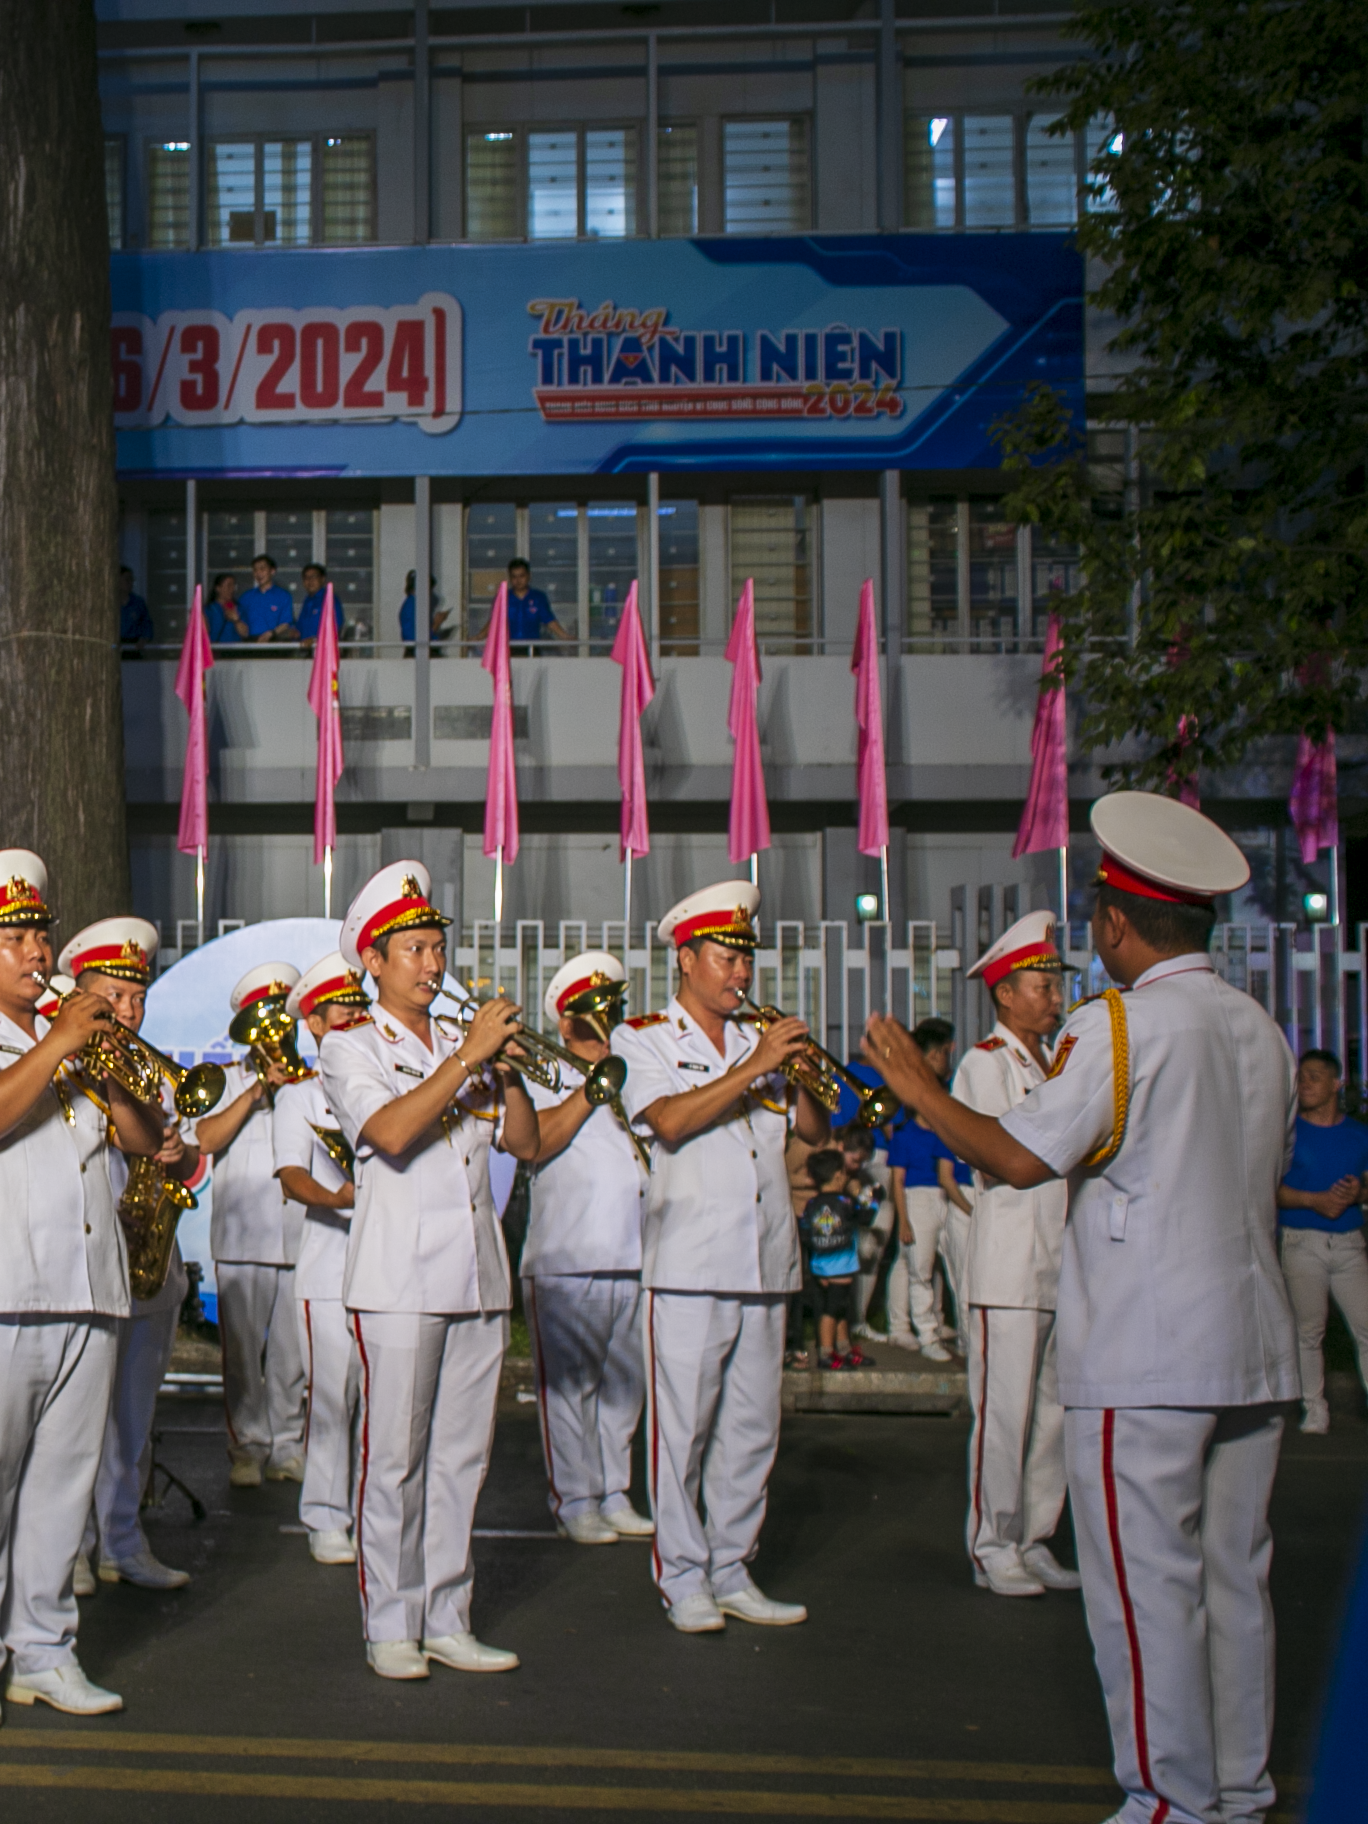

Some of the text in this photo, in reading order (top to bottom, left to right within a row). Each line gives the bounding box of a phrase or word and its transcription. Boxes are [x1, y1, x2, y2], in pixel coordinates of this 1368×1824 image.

[527, 298, 677, 344] Tháng
[111, 306, 447, 420] 6/3/2024)
[531, 324, 901, 386] THANH NIÊN
[804, 383, 902, 417] 2024
